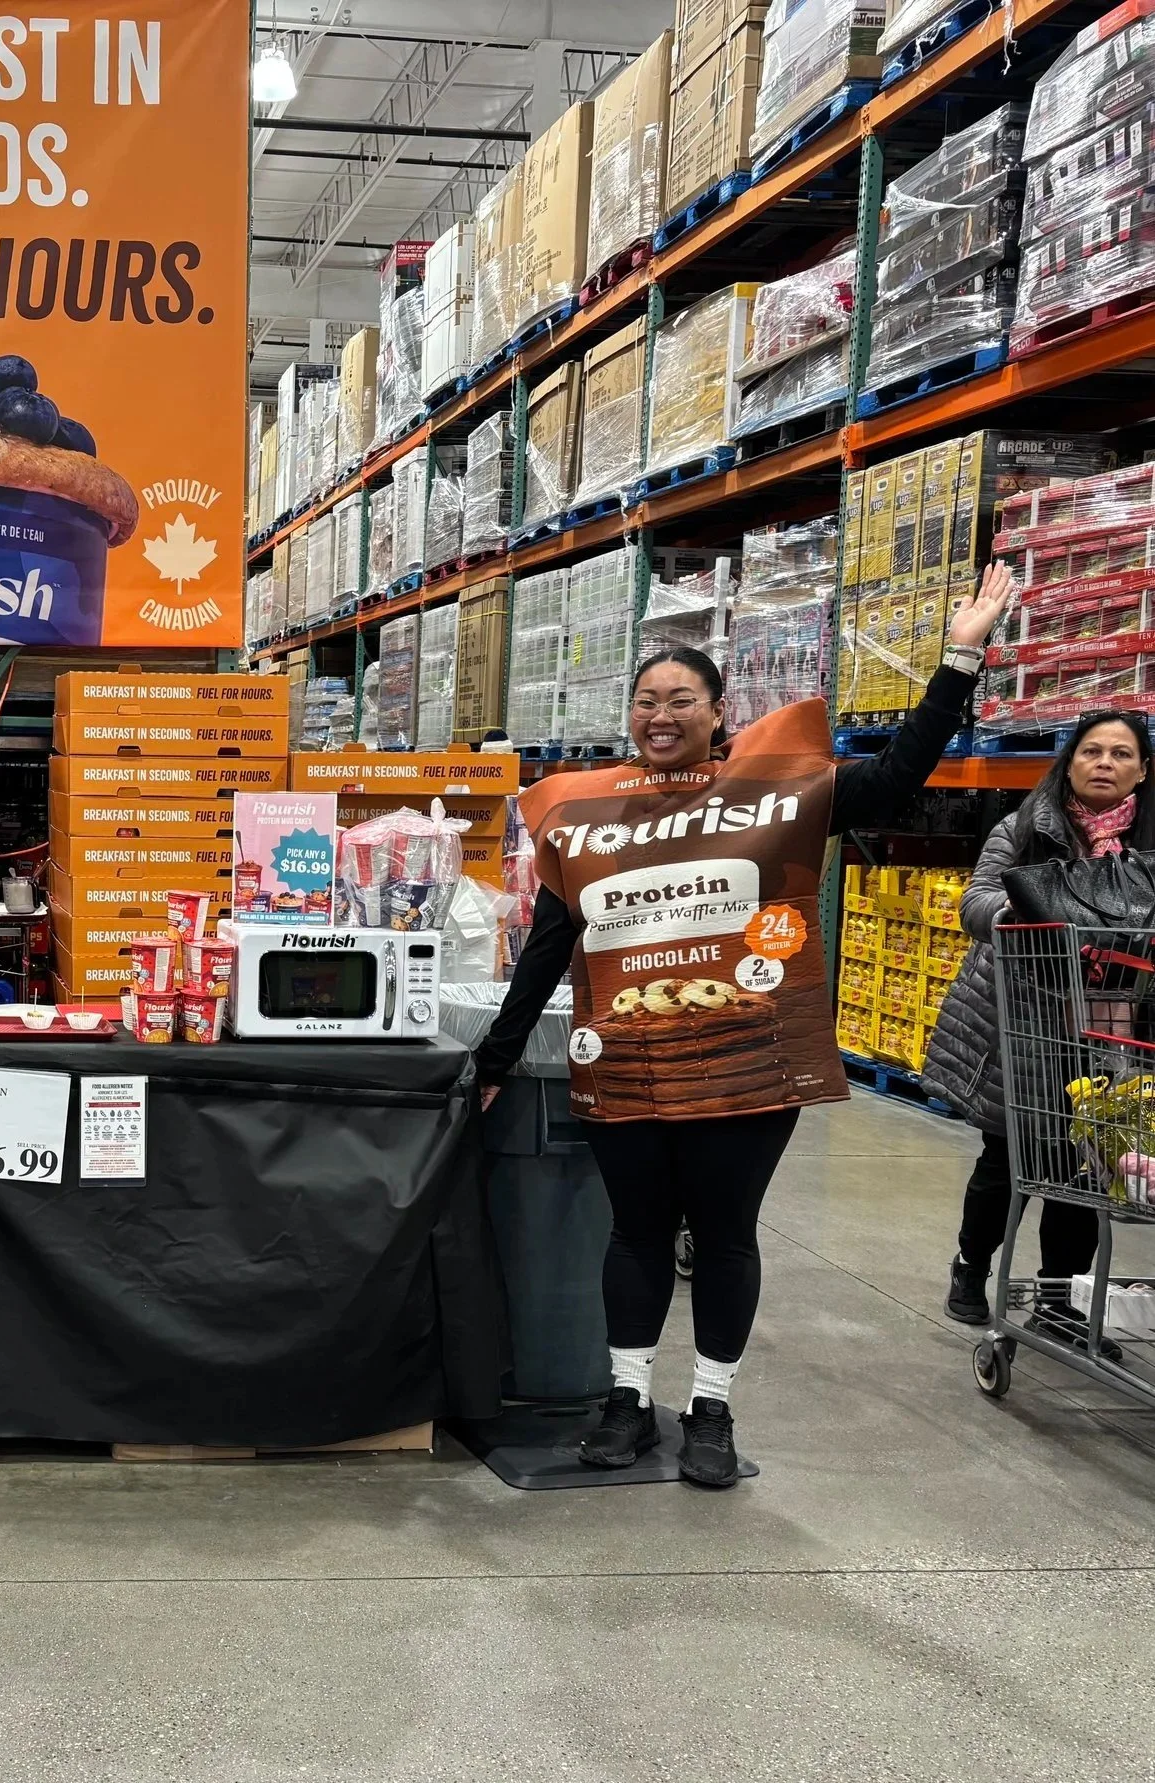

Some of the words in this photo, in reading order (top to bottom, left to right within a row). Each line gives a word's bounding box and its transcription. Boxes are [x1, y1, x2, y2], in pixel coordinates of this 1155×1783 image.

[94, 19, 160, 105] IN
[141, 479, 222, 510] PROUDLY
[10, 526, 21, 538] DE
[23, 527, 45, 543] L'EAU
[139, 597, 222, 631] CANADIAN
[84, 686, 135, 699] BREAKFAST
[138, 686, 147, 699] IN
[150, 687, 194, 699] SECONDS.
[196, 688, 219, 700] FUEL
[221, 688, 238, 700] FOR
[241, 688, 274, 700] HOURS.
[307, 766, 360, 777] BREAKFAST
[362, 766, 372, 778] IN
[374, 766, 420, 778] SECONDS.
[423, 766, 446, 778] FUEL
[448, 766, 467, 778] FOR
[469, 766, 504, 778] HOURS.
[614, 778, 641, 790] JUST
[644, 773, 666, 786] ADD
[670, 772, 710, 783] WATER
[252, 801, 317, 816] Flourish
[257, 817, 278, 825] PROTEIN
[281, 817, 293, 825] MUG
[294, 817, 313, 825] CAKES
[286, 848, 303, 859] PICK
[305, 849, 319, 860] ANY
[320, 851, 326, 859] 8
[280, 858, 331, 875] $16.99
[603, 875, 730, 911] Protein
[589, 914, 648, 933] Pancake
[653, 911, 663, 922] &
[669, 903, 717, 922] Waffle
[722, 901, 749, 913] Mix
[759, 912, 796, 940] 24g
[281, 933, 356, 948] Flourish
[621, 944, 721, 973] CHOCOLATE
[752, 959, 769, 977] 2g
[745, 979, 752, 987] OF
[576, 1032, 587, 1052] 7g
